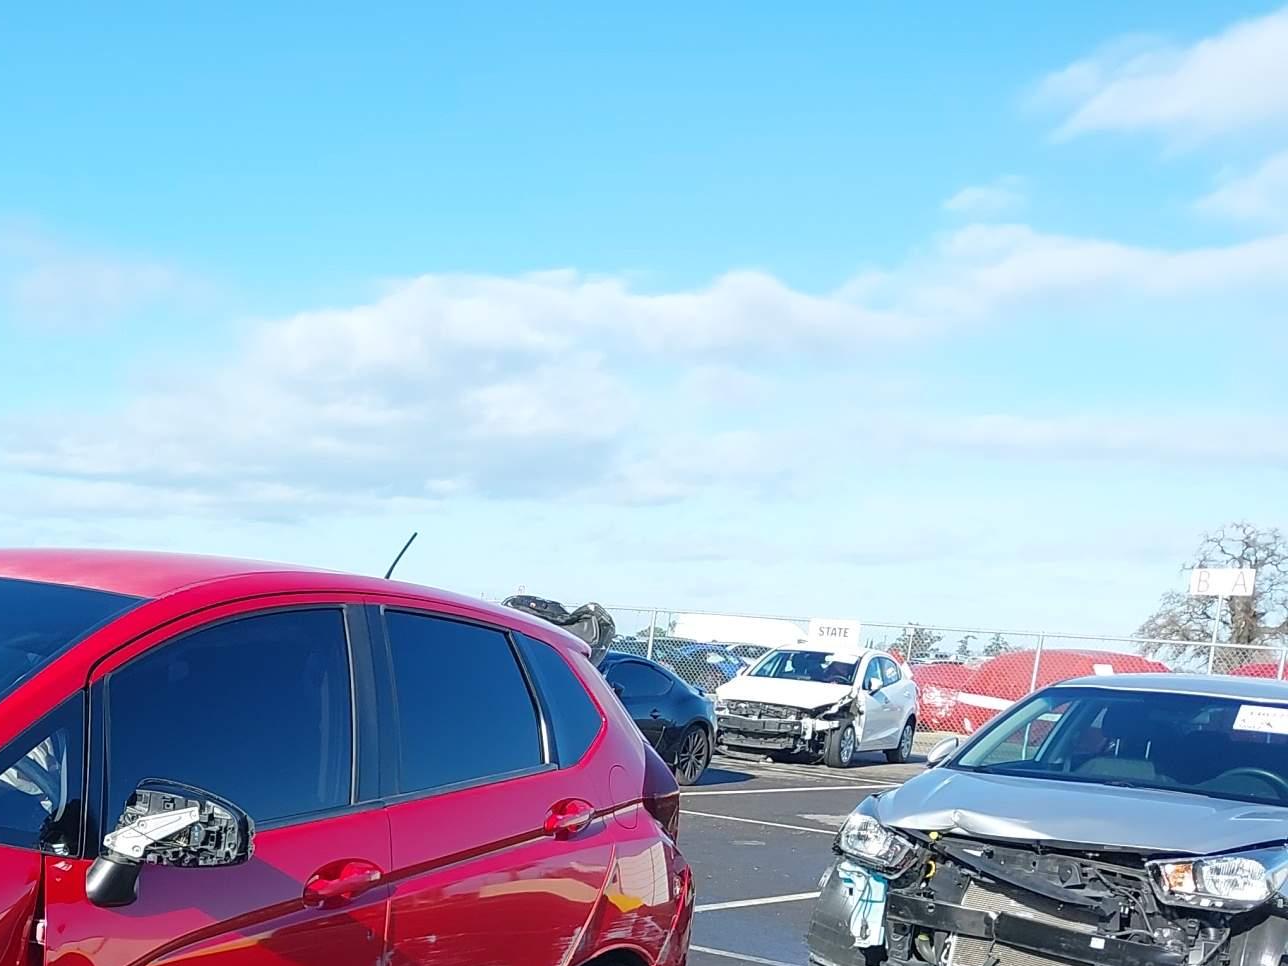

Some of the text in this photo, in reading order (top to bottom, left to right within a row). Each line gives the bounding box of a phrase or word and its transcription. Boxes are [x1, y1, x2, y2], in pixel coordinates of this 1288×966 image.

[1197, 570, 1247, 593] B A
[818, 626, 849, 638] STATE
